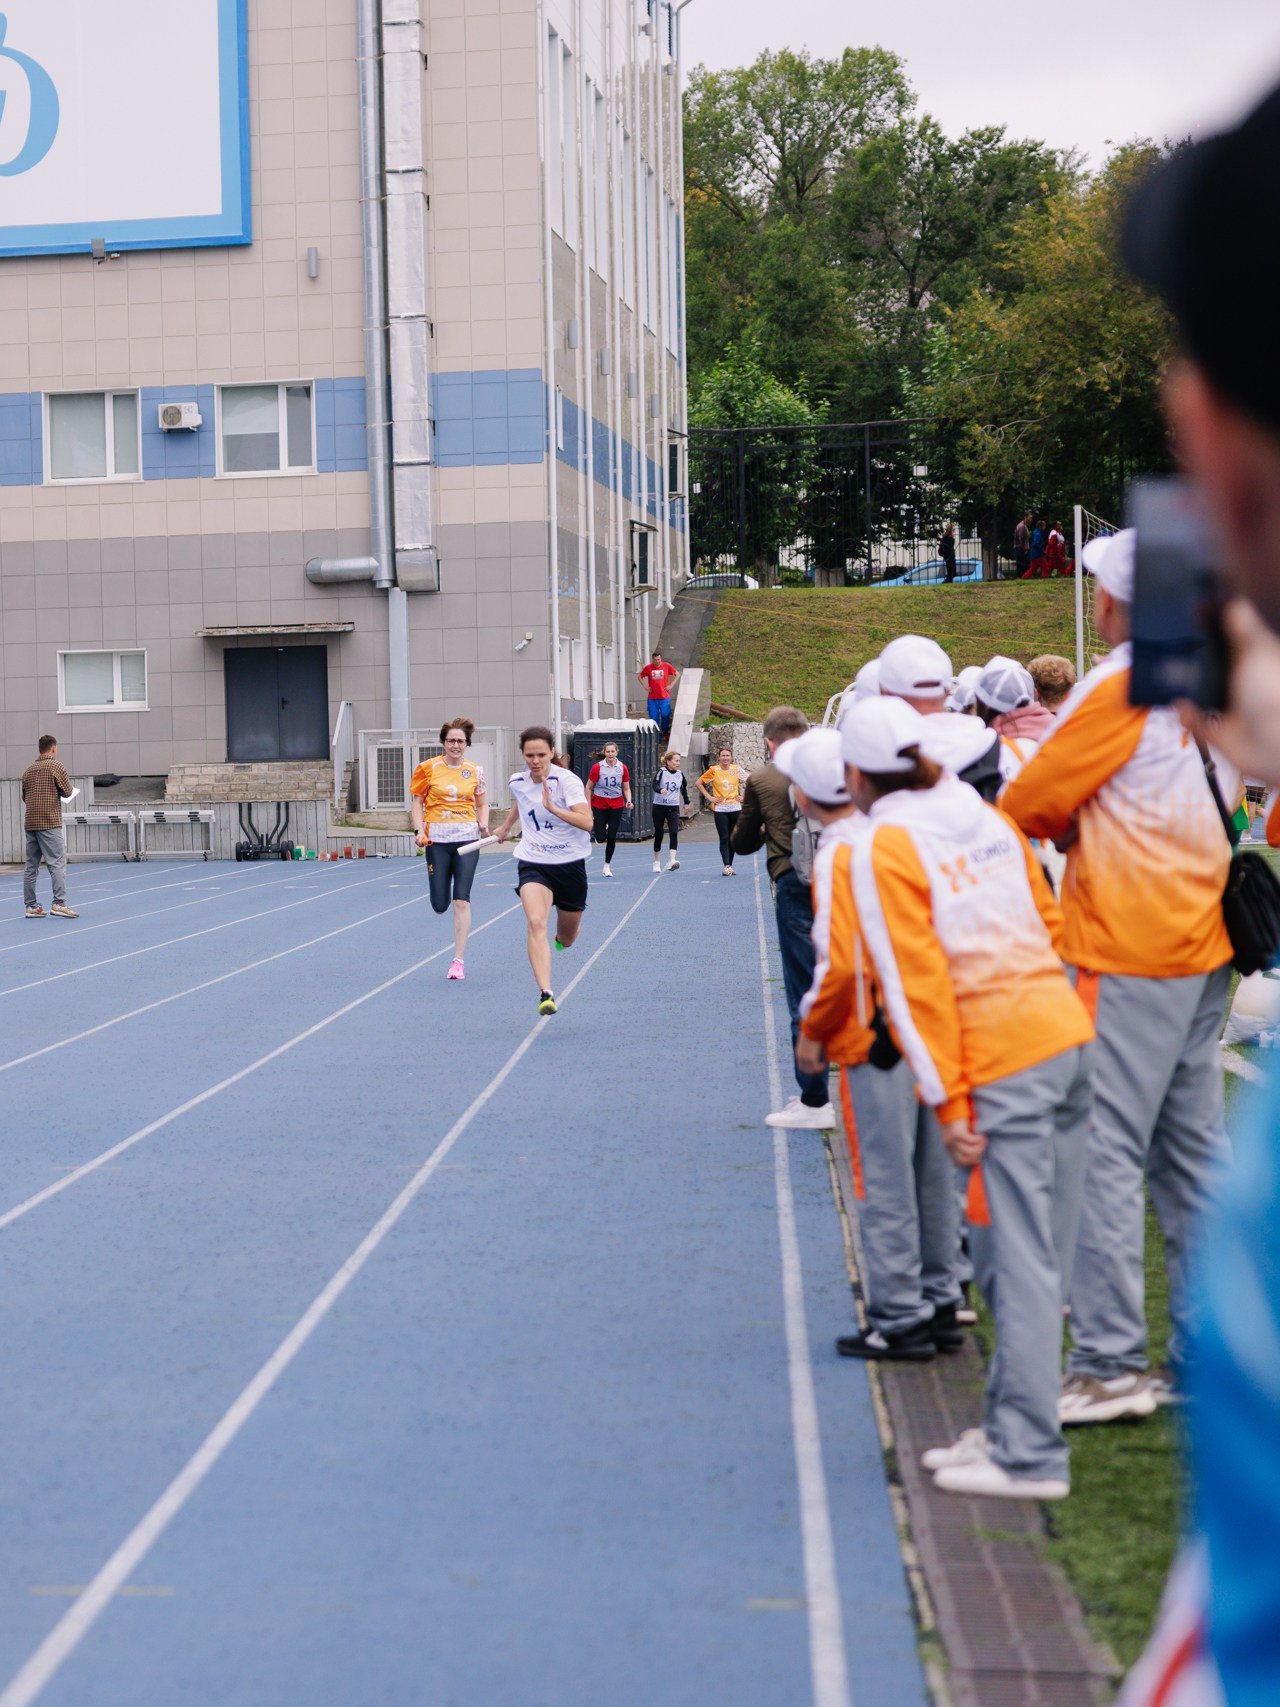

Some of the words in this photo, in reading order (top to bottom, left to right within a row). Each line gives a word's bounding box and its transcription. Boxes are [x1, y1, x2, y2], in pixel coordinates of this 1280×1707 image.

[604, 776, 617, 787] 13
[665, 781, 677, 792] 13
[722, 779, 729, 791] 3
[445, 784, 458, 802] 3
[528, 809, 540, 831] 1
[544, 820, 554, 831] 4
